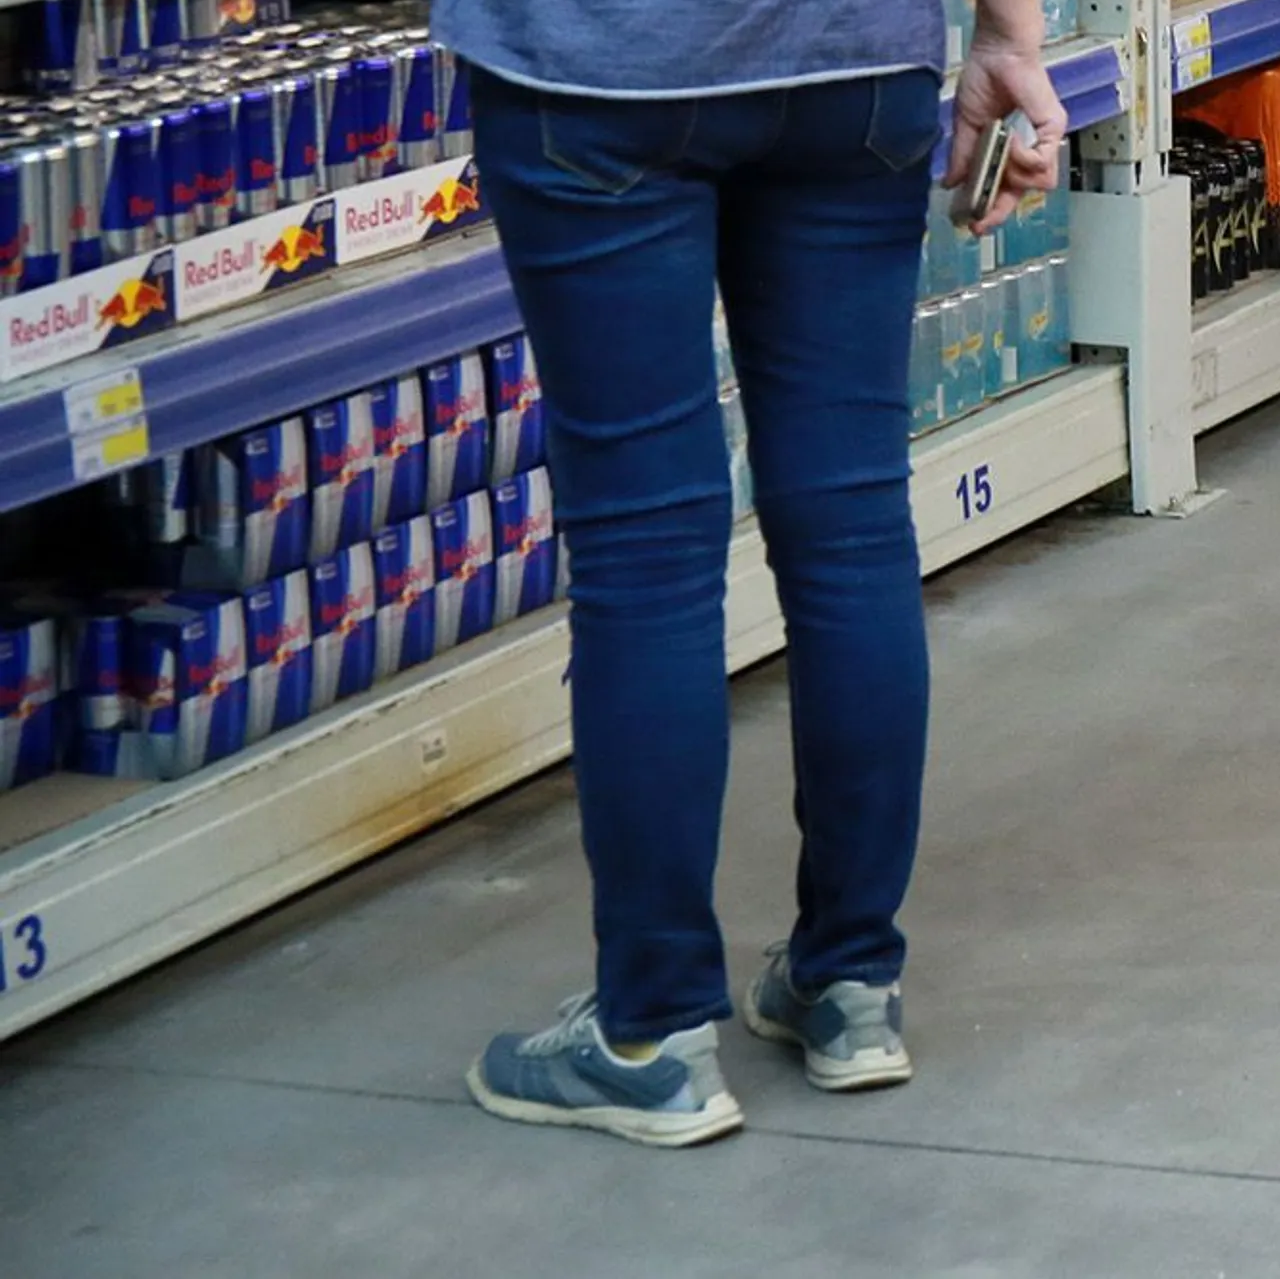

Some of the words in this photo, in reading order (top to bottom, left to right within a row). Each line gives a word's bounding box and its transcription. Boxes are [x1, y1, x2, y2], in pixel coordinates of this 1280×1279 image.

[345, 200, 380, 235] Red
[382, 189, 415, 225] Bull
[185, 252, 218, 288] Red
[222, 241, 254, 276] Bull
[10, 306, 49, 348] Red
[51, 295, 89, 335] Bull
[956, 464, 992, 519] 15
